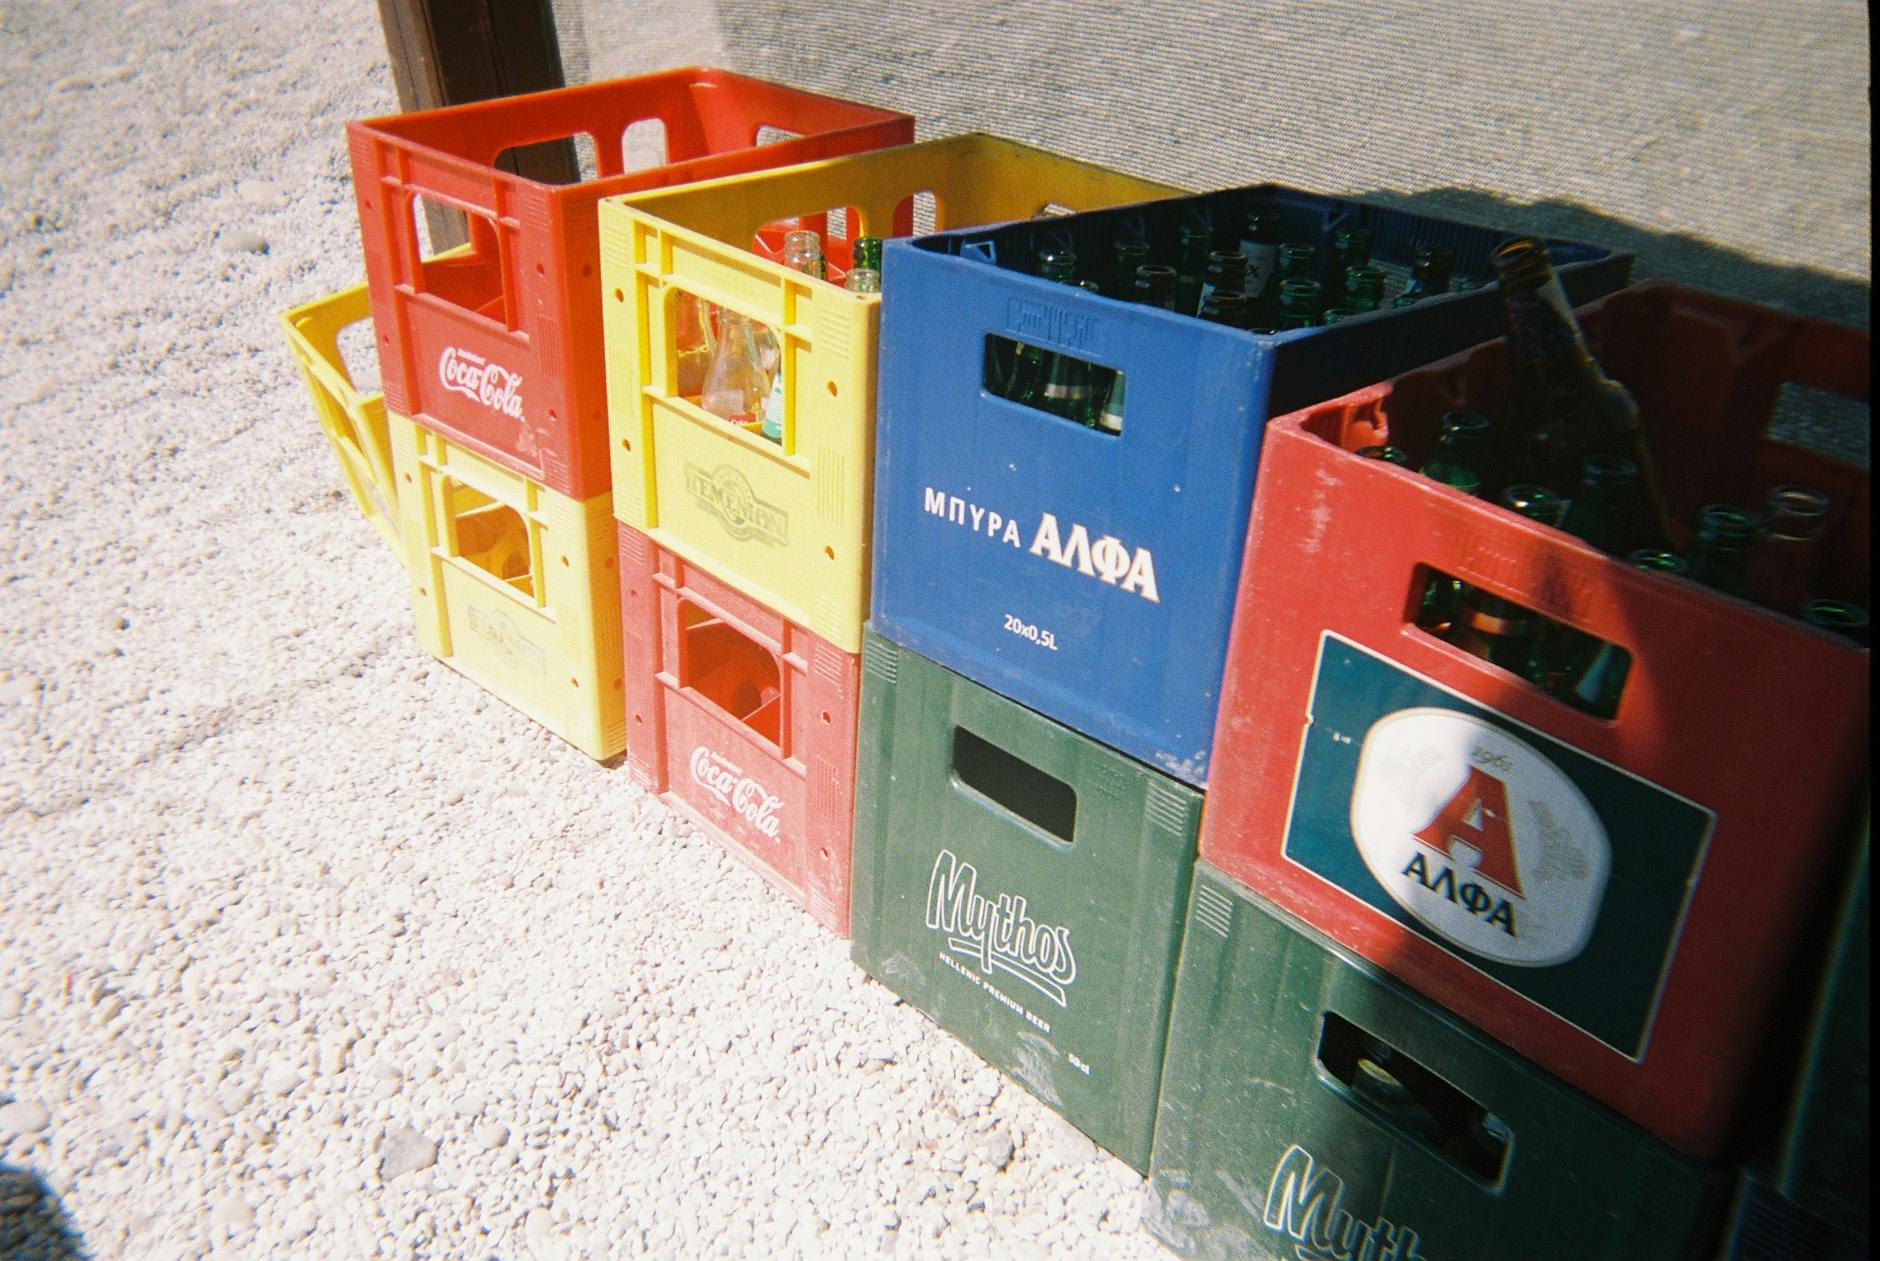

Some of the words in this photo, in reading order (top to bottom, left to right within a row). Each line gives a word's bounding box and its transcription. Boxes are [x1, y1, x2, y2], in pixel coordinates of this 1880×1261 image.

[440, 346, 523, 419] Coca-Cola
[924, 487, 1021, 548] ΜΠΥΡΑ
[1029, 511, 1161, 603] ΑΛΦΑ
[1004, 614, 1058, 650] 20x0,5L
[690, 746, 784, 838] Coca-Cola
[926, 849, 1077, 985] Mythos
[1400, 851, 1517, 938] ΑΛΦΑ
[939, 952, 981, 985] HELLENIC
[983, 981, 1024, 1015] PREMIUM
[1025, 1010, 1052, 1033] BEER
